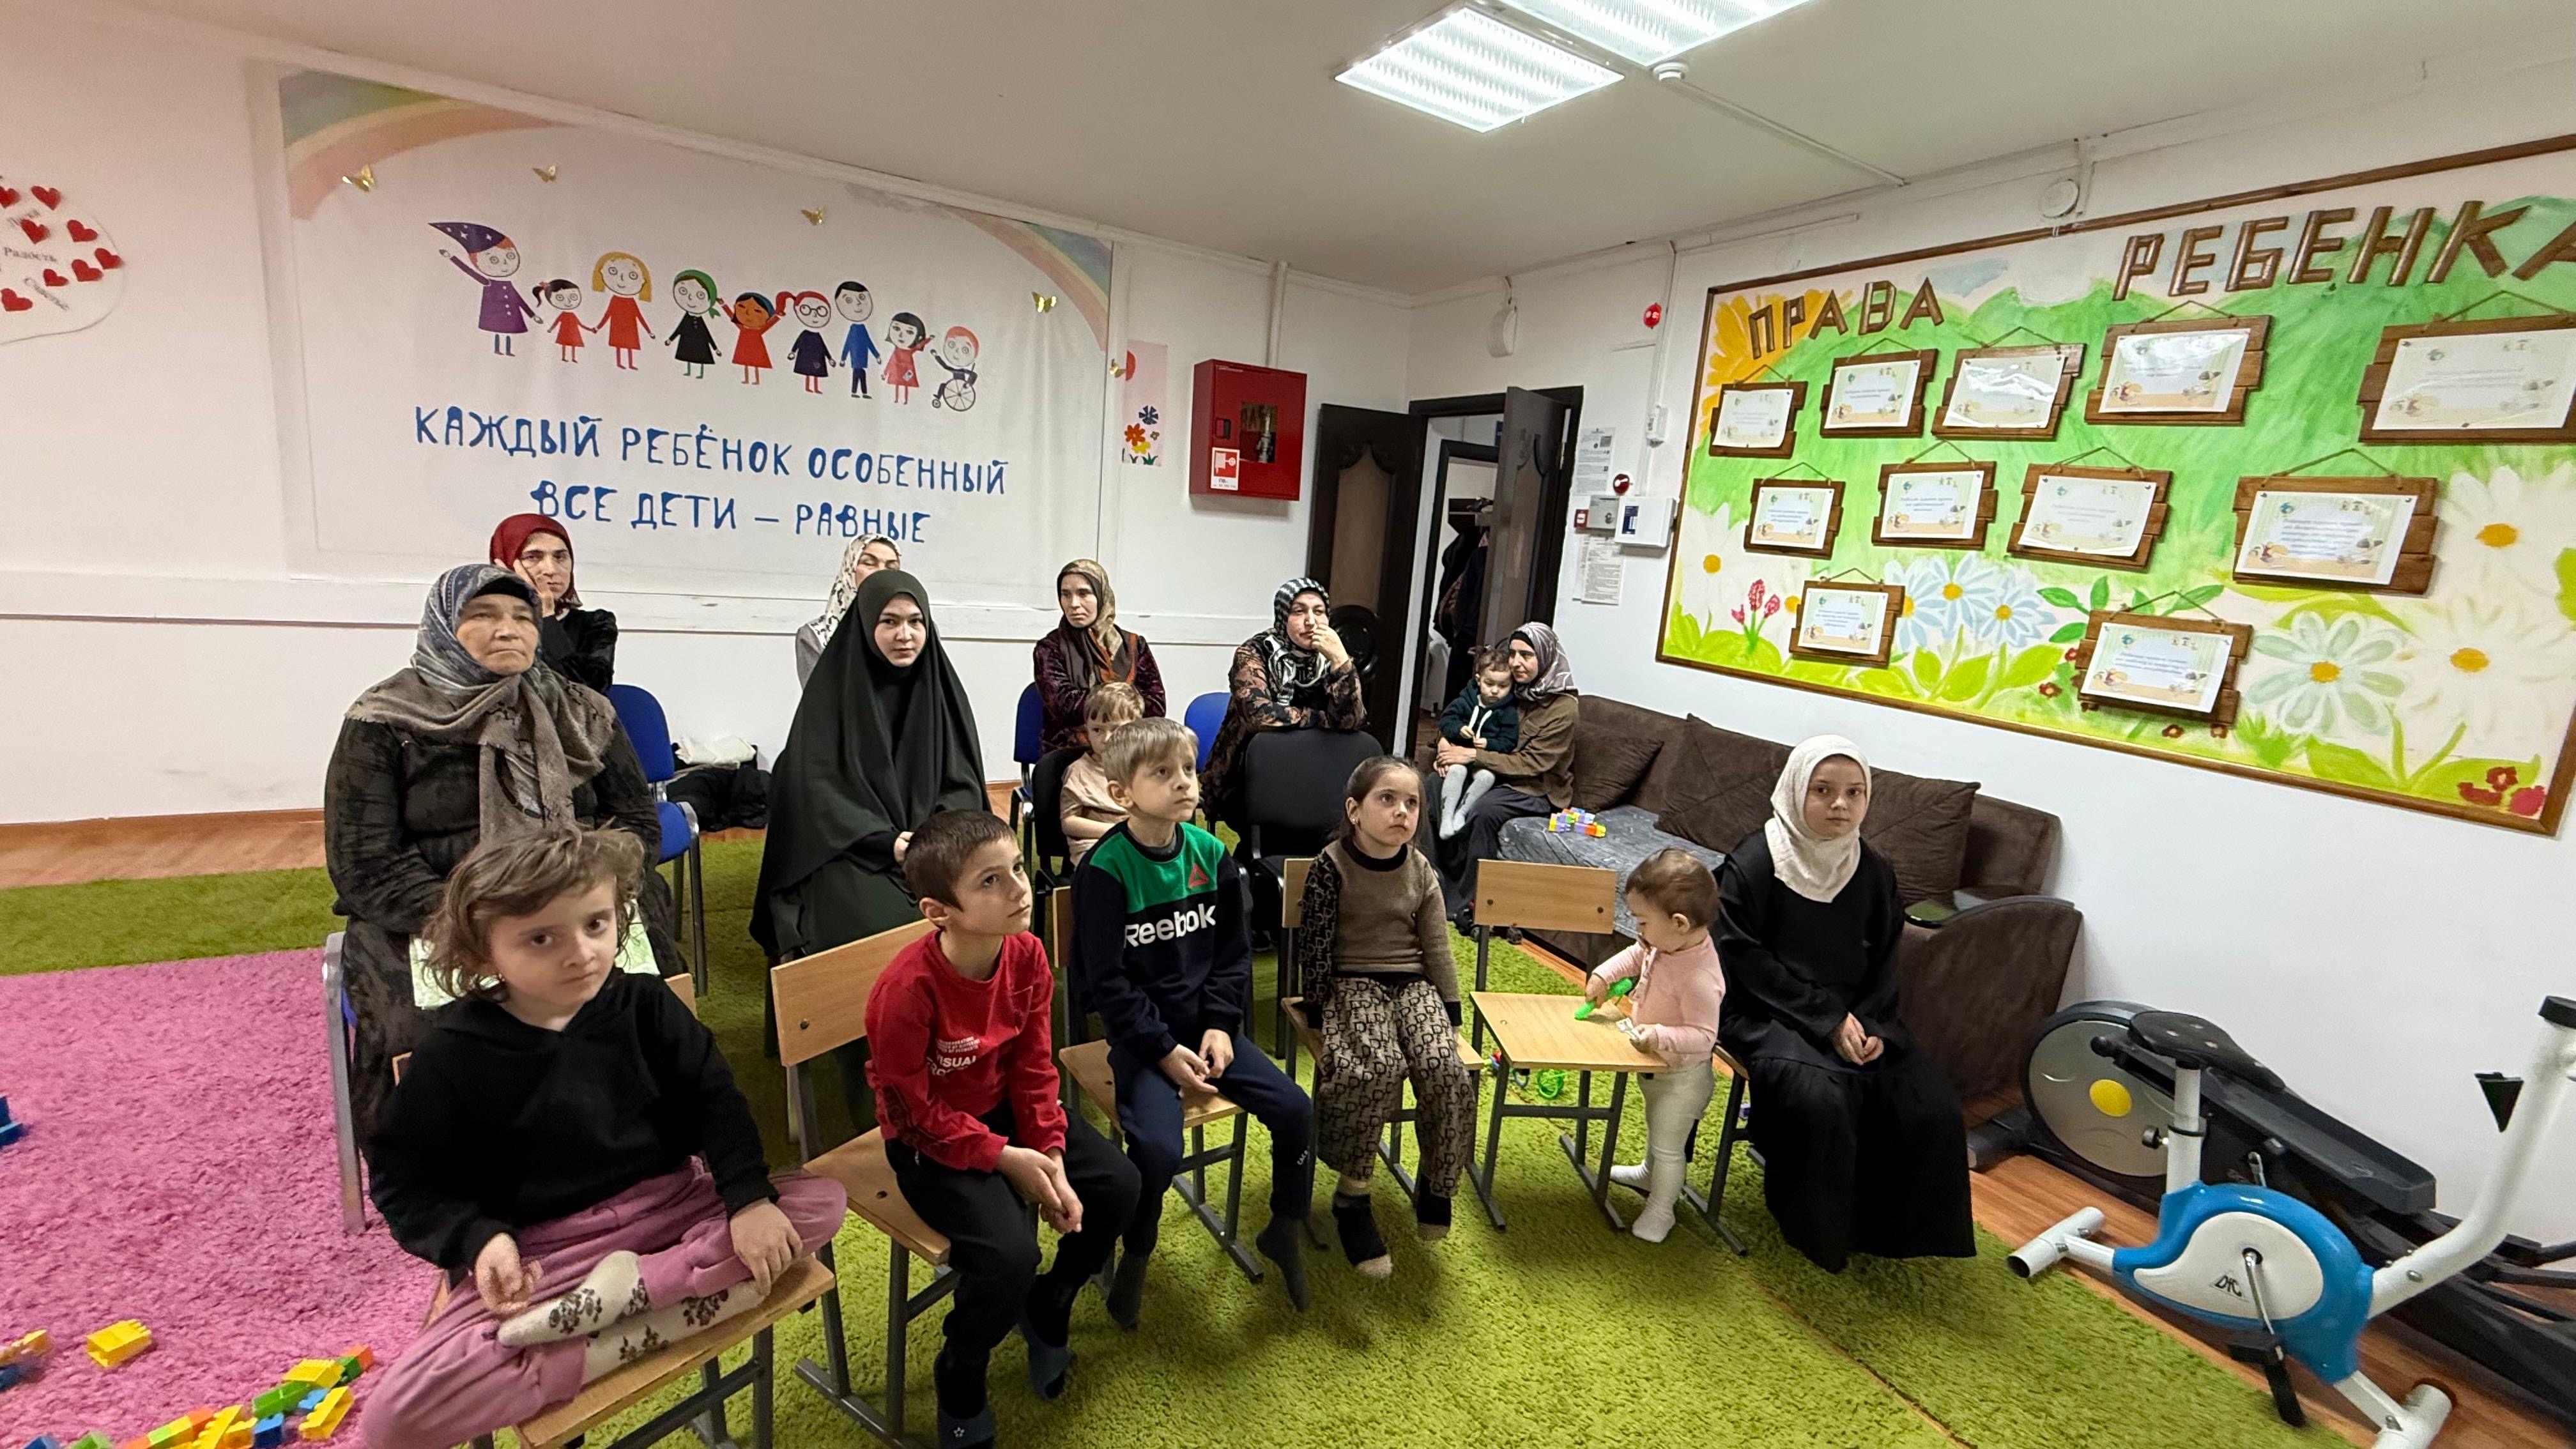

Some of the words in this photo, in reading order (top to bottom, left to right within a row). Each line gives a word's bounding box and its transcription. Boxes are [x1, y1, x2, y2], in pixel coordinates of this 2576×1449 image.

[1748, 276, 1944, 360] ПРАВА
[415, 406, 602, 458] КАЖДЫЙ
[622, 424, 792, 475] РЕБЁНОК
[808, 447, 1008, 494] ОСОБЕННЫЙ
[530, 480, 618, 522] ВСЕ
[631, 491, 737, 530] ДЕТИ
[795, 502, 931, 543] РАВНЫЕ
[1123, 903, 1216, 949] Reebok
